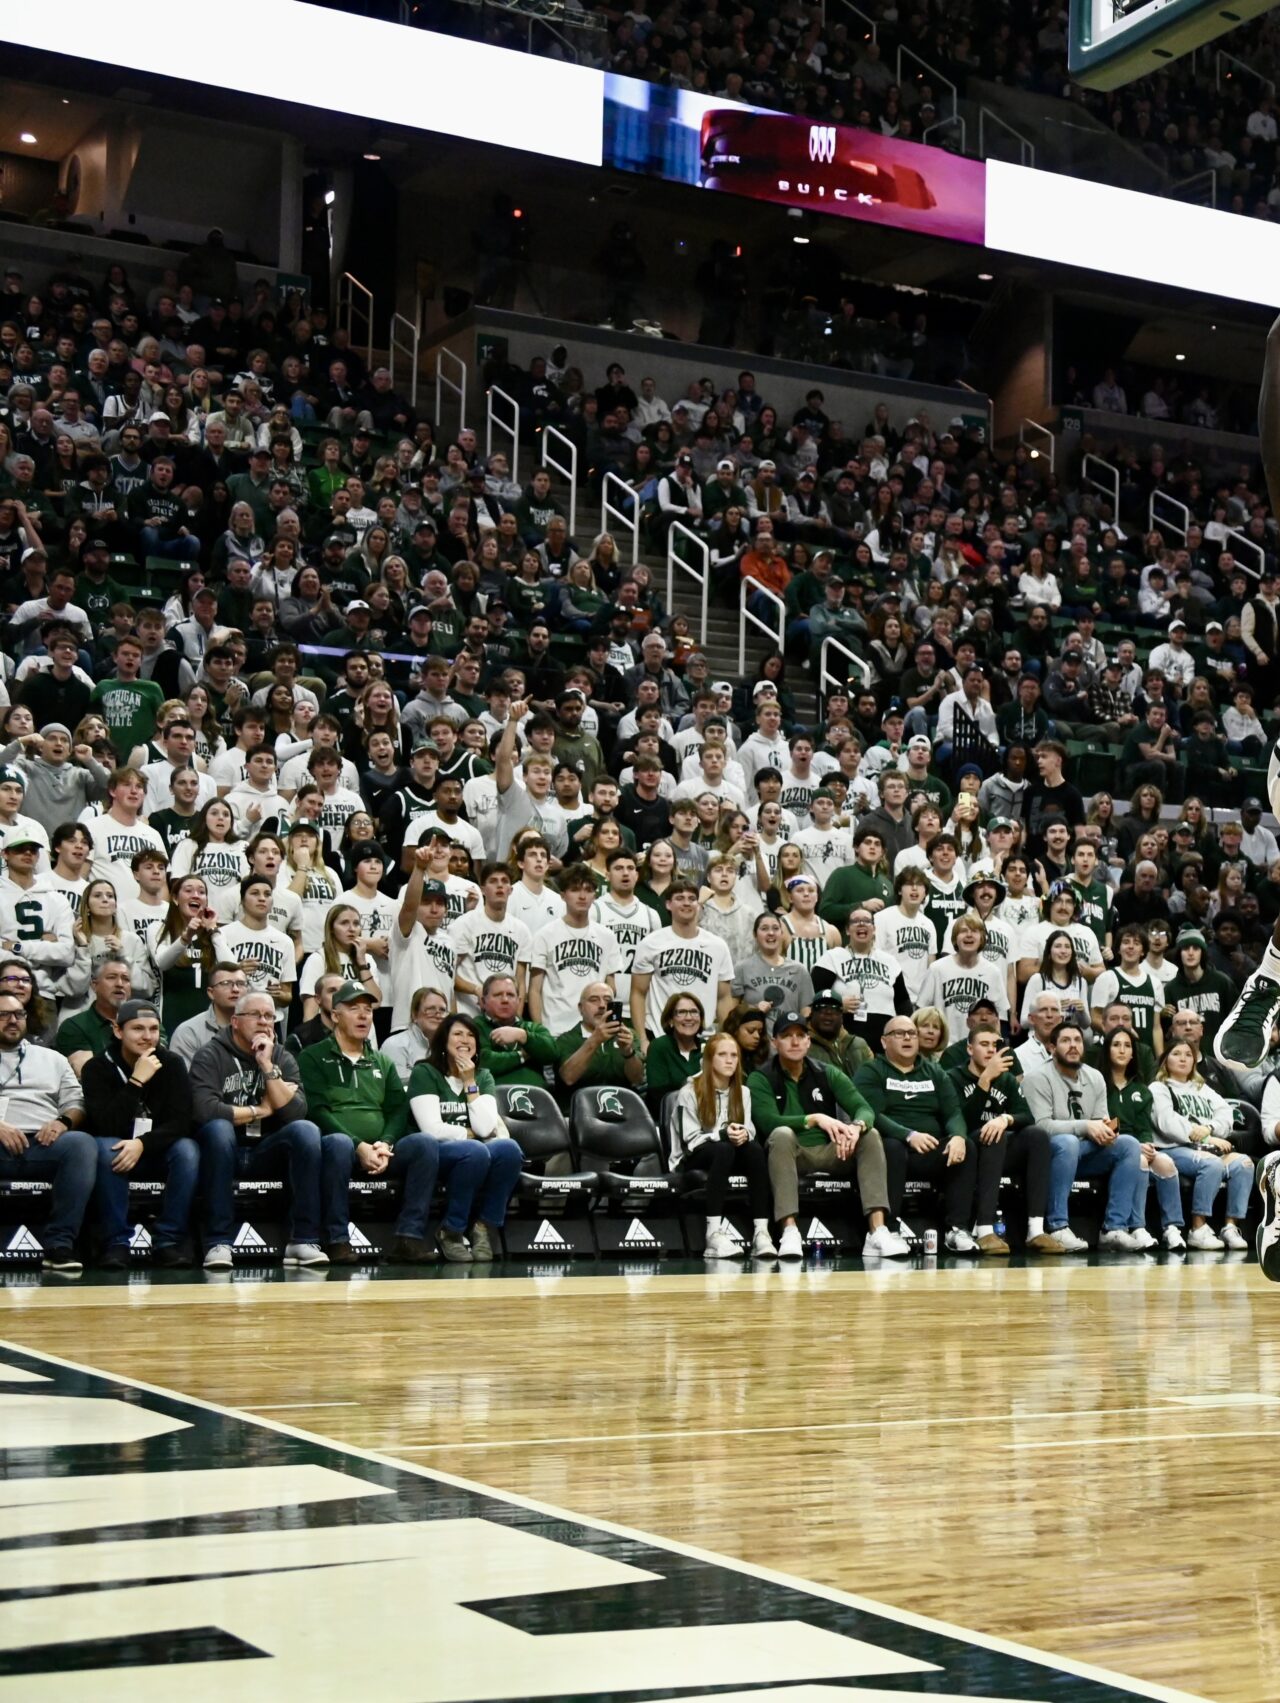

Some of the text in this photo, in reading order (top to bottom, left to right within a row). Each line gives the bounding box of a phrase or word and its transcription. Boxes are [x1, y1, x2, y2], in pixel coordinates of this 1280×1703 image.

[777, 180, 873, 206] BUICK
[15, 900, 44, 940] S
[555, 938, 604, 964] IZZONE
[659, 948, 713, 973] IZZONE
[840, 957, 890, 981] IZZONE
[750, 975, 799, 993] SPARTANS
[942, 977, 989, 1001] IZZONE
[1132, 1007, 1147, 1028] 11
[11, 1181, 52, 1190] SPARTAN
[239, 1181, 283, 1190] SPARTANS
[541, 1181, 582, 1189] SPARTANS
[629, 1180, 669, 1189] SPARTANS
[815, 1180, 851, 1189] SPARTANS
